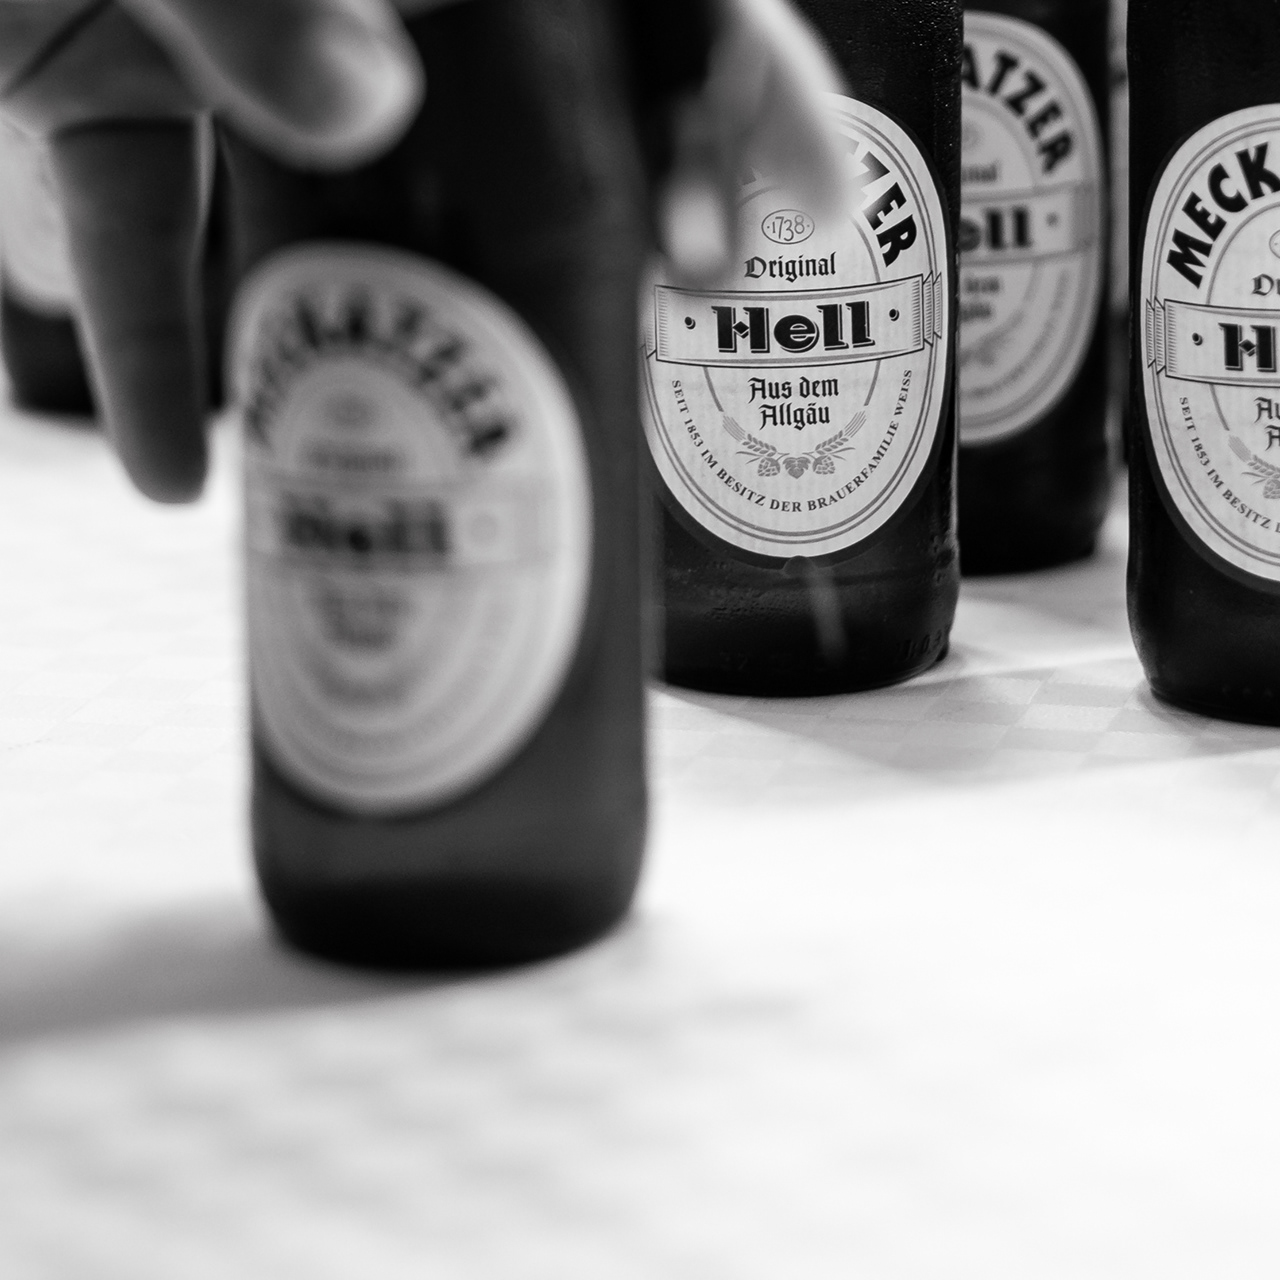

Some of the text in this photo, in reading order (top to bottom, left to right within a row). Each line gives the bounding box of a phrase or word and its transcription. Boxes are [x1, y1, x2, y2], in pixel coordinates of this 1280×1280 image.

[772, 215, 805, 242] 1738
[744, 251, 836, 283] Original
[711, 300, 876, 353] Hell
[747, 376, 839, 404] Aus dem
[758, 402, 831, 431] Allgäu
[672, 369, 912, 512] SEIT 1853 IM BESITZ DER BRAUERFAMILIE WEISS
[1179, 396, 1195, 430] SEIT
[1191, 437, 1210, 467] 1853
[1207, 468, 1224, 489] IM
[1222, 489, 1271, 529] BESITZ
